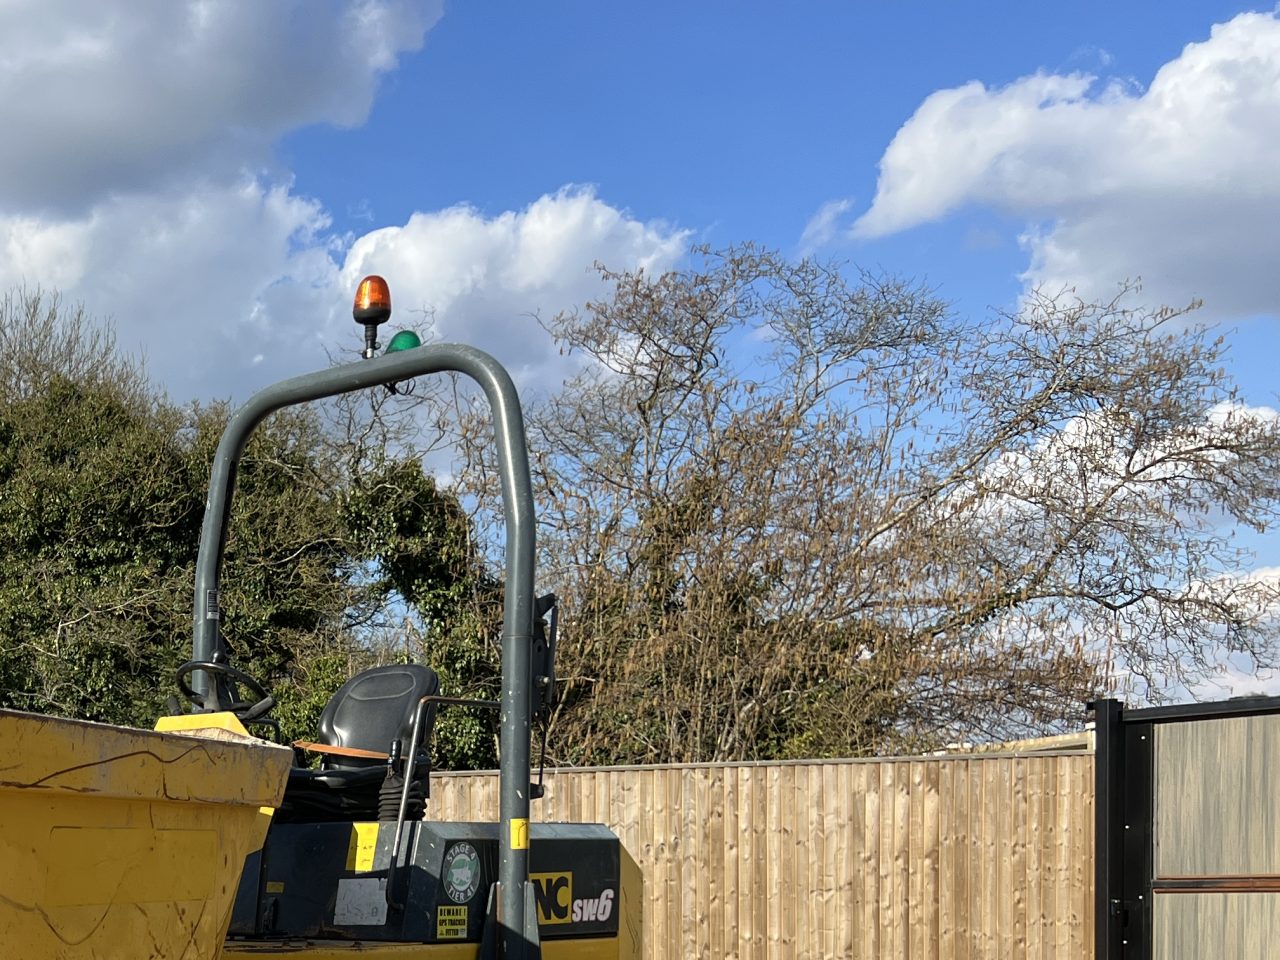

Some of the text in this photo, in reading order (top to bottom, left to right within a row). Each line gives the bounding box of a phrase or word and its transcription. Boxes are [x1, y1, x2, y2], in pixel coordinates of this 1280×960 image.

[446, 843, 471, 863] STAGE
[448, 885, 465, 902] TIER
[531, 876, 569, 920] NC
[439, 918, 466, 926] GPS TRACKER
[445, 928, 459, 936] FITTED
